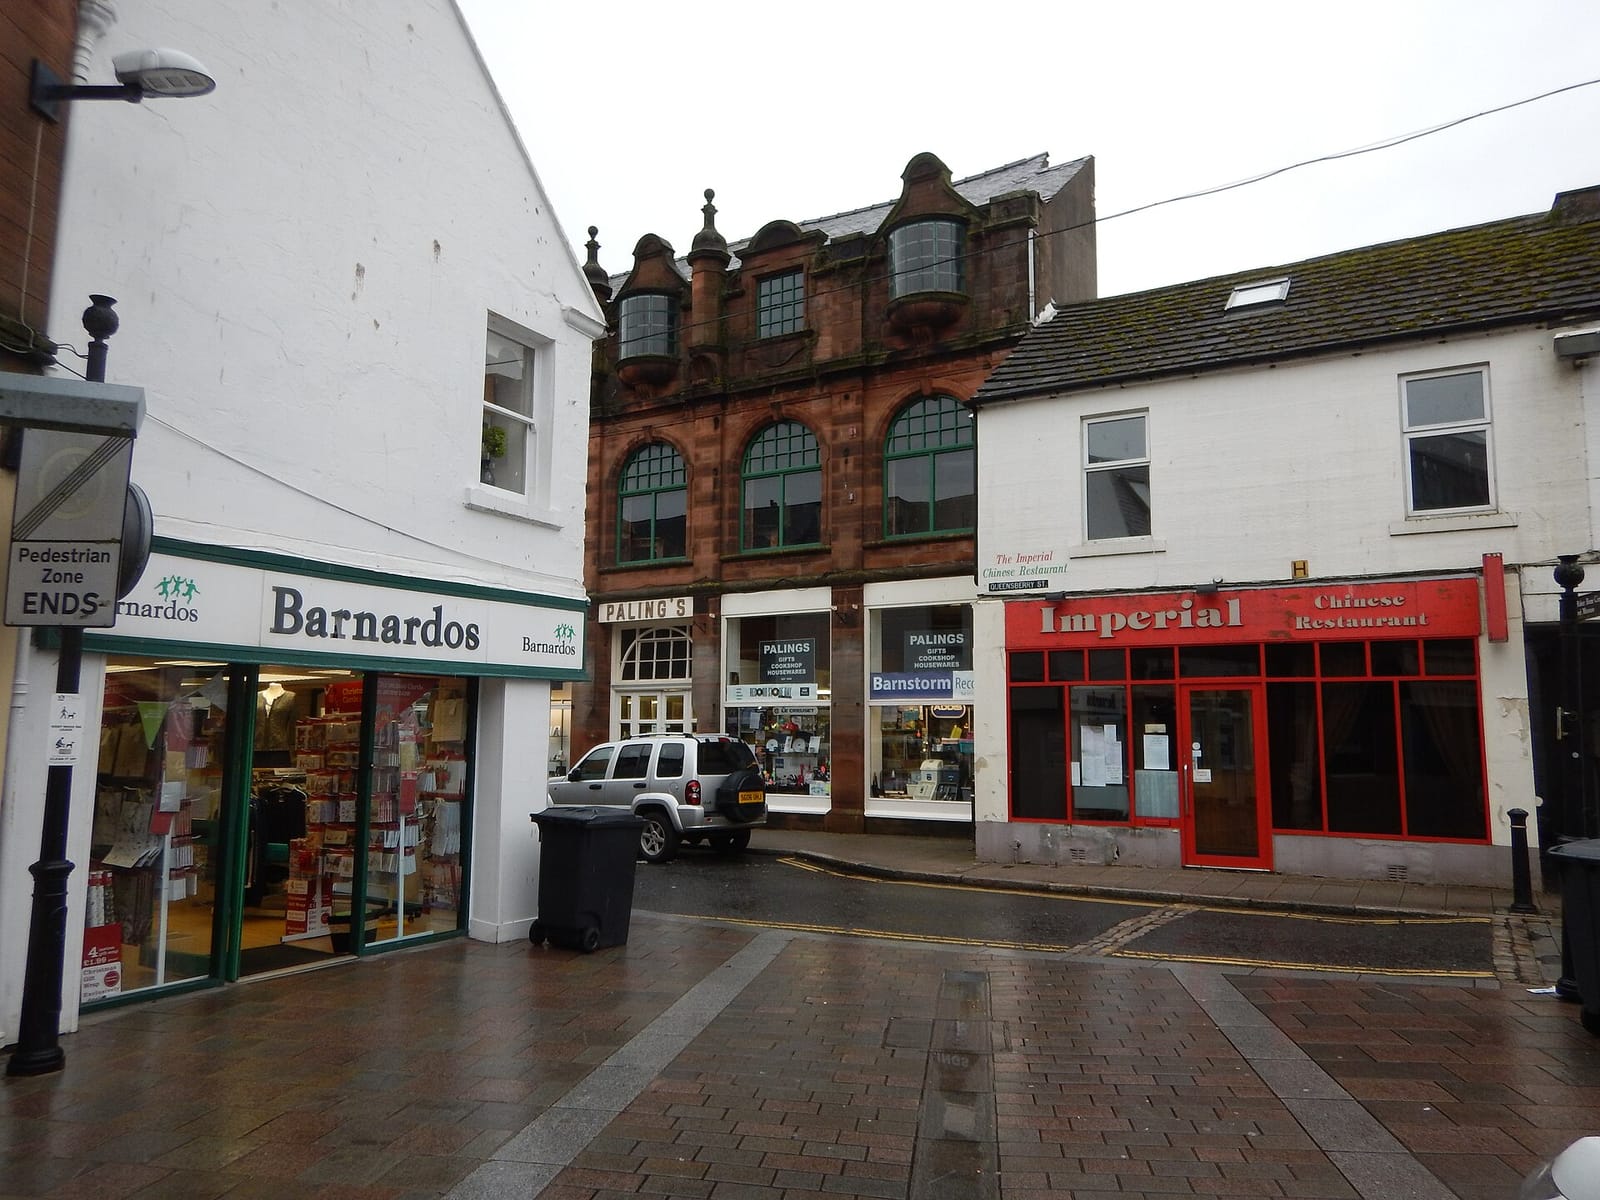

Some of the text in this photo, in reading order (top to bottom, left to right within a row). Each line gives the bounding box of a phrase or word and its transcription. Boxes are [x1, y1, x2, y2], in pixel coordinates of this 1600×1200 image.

[19, 548, 110, 563] Pedestrian
[996, 551, 1053, 565] The Imperial
[41, 568, 84, 583] Zone
[982, 564, 1068, 578] Chinese Restaurant
[990, 581, 1035, 590] QUEENSBERRY
[23, 592, 99, 614] ENDS
[1314, 592, 1405, 609] Chinese
[116, 599, 199, 622] rnardos
[606, 598, 686, 621] PALING'S
[269, 586, 480, 650] Barnardos
[1040, 598, 1244, 639] Imperial
[1295, 612, 1429, 630] Restaurant
[522, 636, 576, 655] Barnardos
[909, 633, 964, 646] PALINGS
[763, 643, 810, 655] PALINGS
[873, 676, 951, 691] Barnstorm
[88, 946, 98, 958] 4
